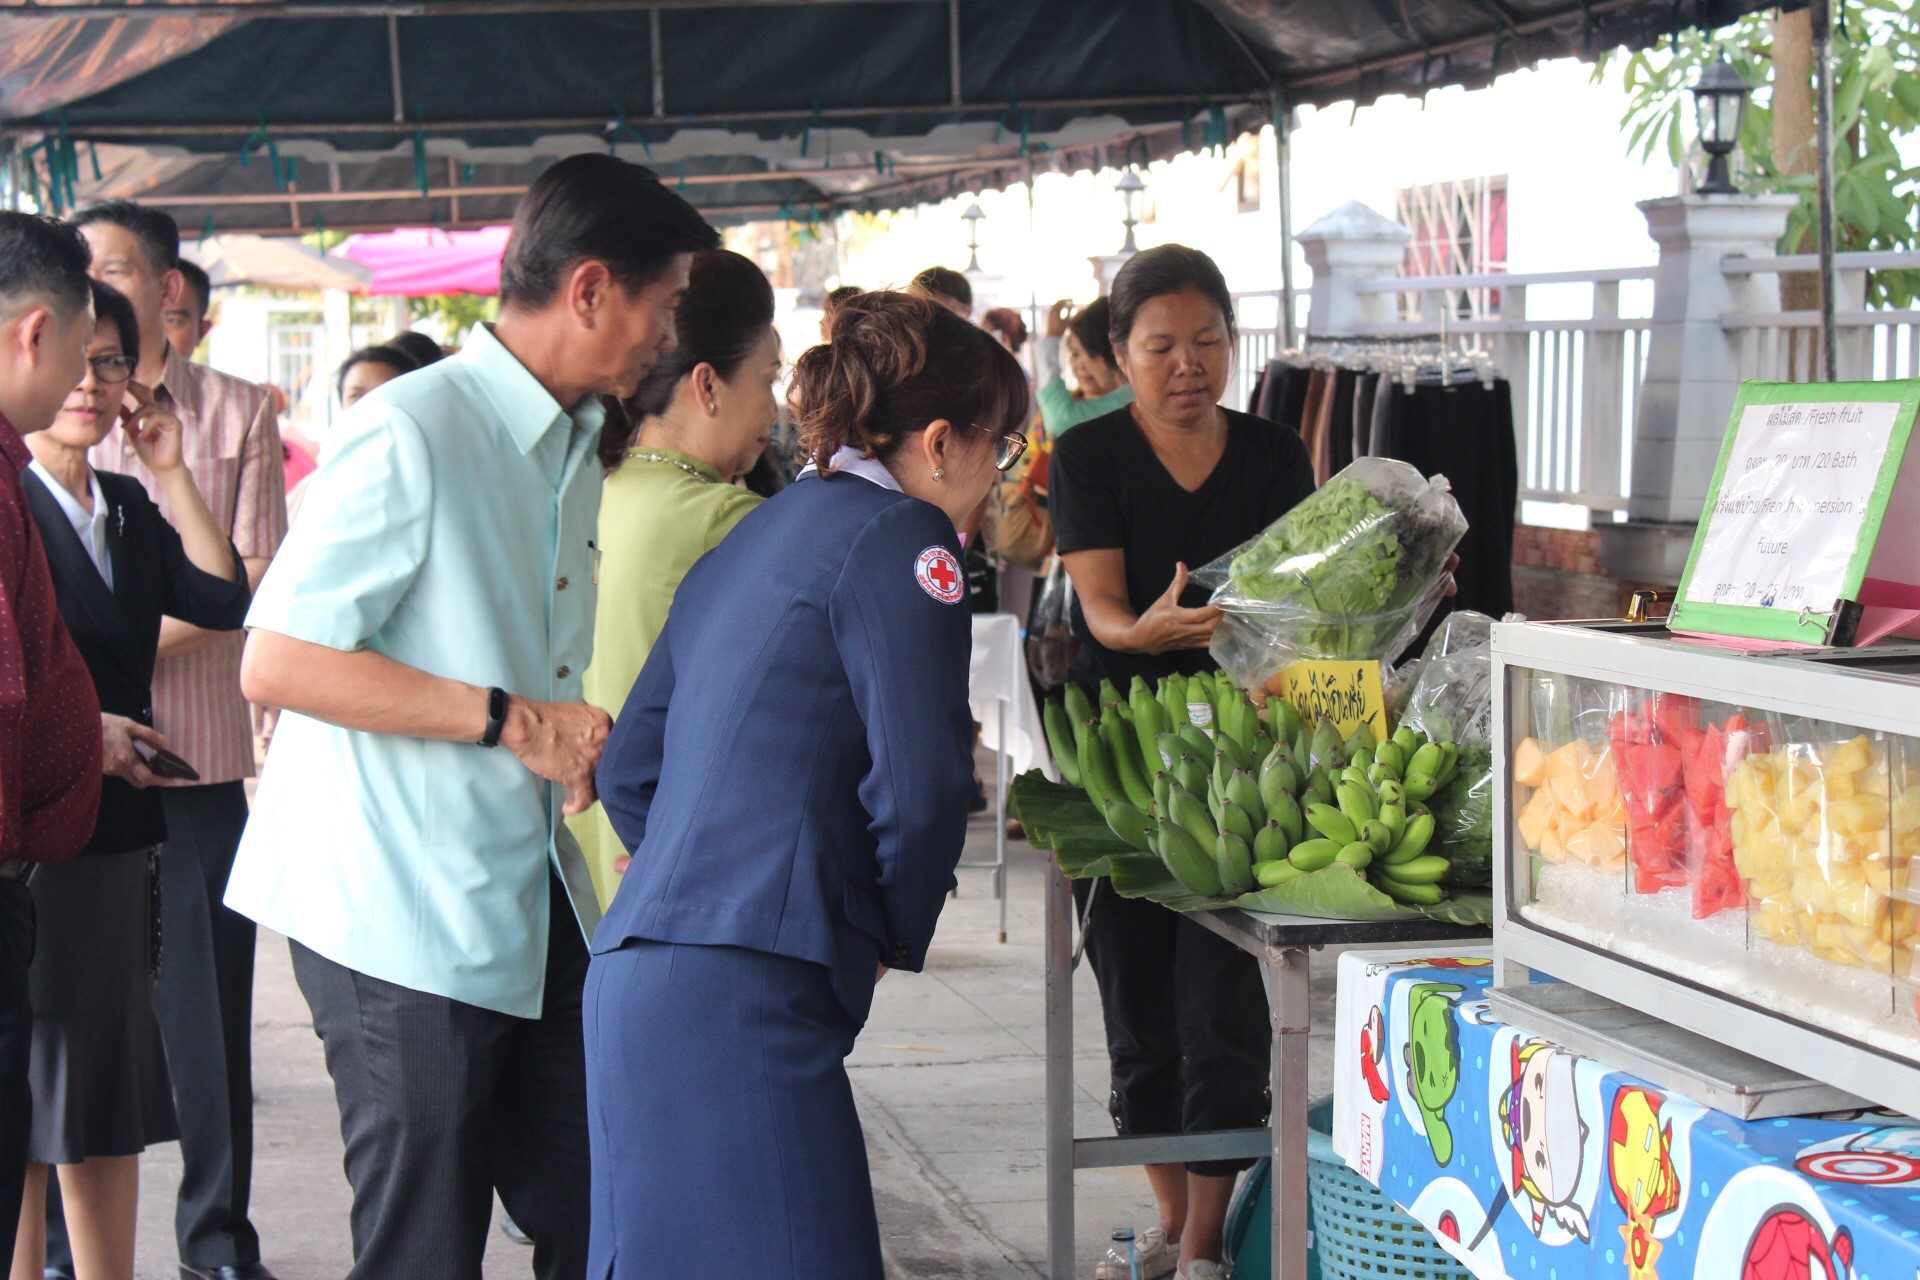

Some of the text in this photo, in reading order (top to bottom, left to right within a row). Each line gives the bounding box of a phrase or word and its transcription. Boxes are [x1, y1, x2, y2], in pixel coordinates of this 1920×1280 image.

[1766, 404, 1864, 427] ผลไม้สด /Fresh fruit
[1791, 454, 1812, 470] บาท
[1811, 452, 1832, 470] /20
[1831, 451, 1858, 469] Bath
[1756, 537, 1789, 555] future
[1743, 581, 1757, 598] 20
[1782, 585, 1805, 600] บาท
[1361, 1112, 1371, 1179] MARVE
